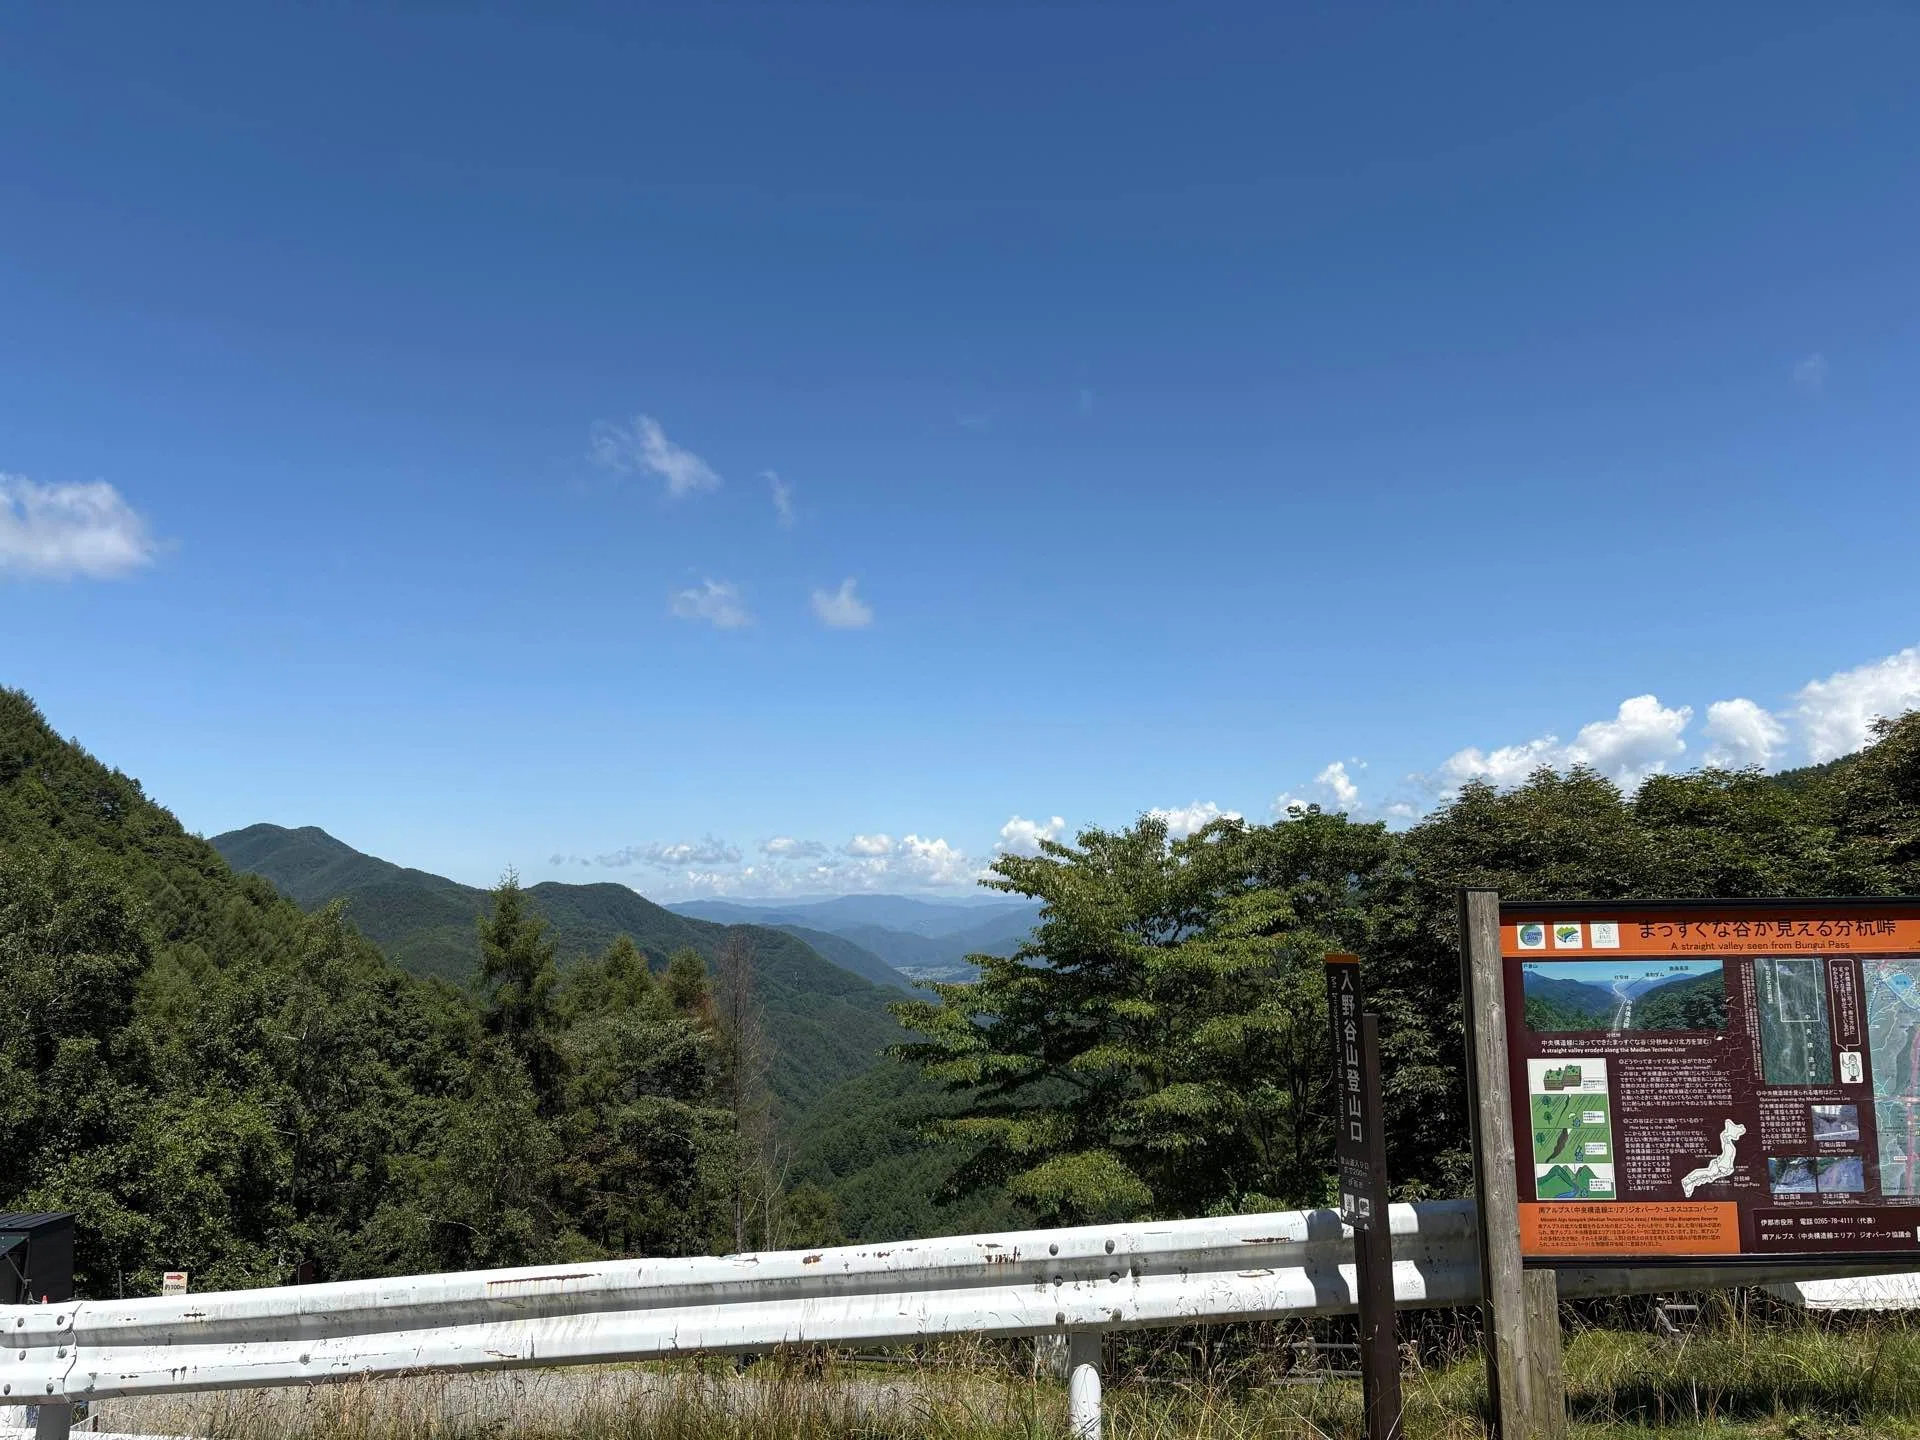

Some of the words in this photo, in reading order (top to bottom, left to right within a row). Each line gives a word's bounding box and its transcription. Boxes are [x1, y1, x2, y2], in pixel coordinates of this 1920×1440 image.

[1639, 918, 1896, 938] まっすぐな谷が見える分杭峠
[1671, 942, 1678, 950] A
[1681, 941, 1715, 951] straight
[1718, 941, 1744, 951] valley
[1772, 941, 1792, 949] from
[1795, 941, 1826, 951] Bungui
[1828, 940, 1850, 949] Pass
[1341, 969, 1362, 1142] 入野谷山登山口
